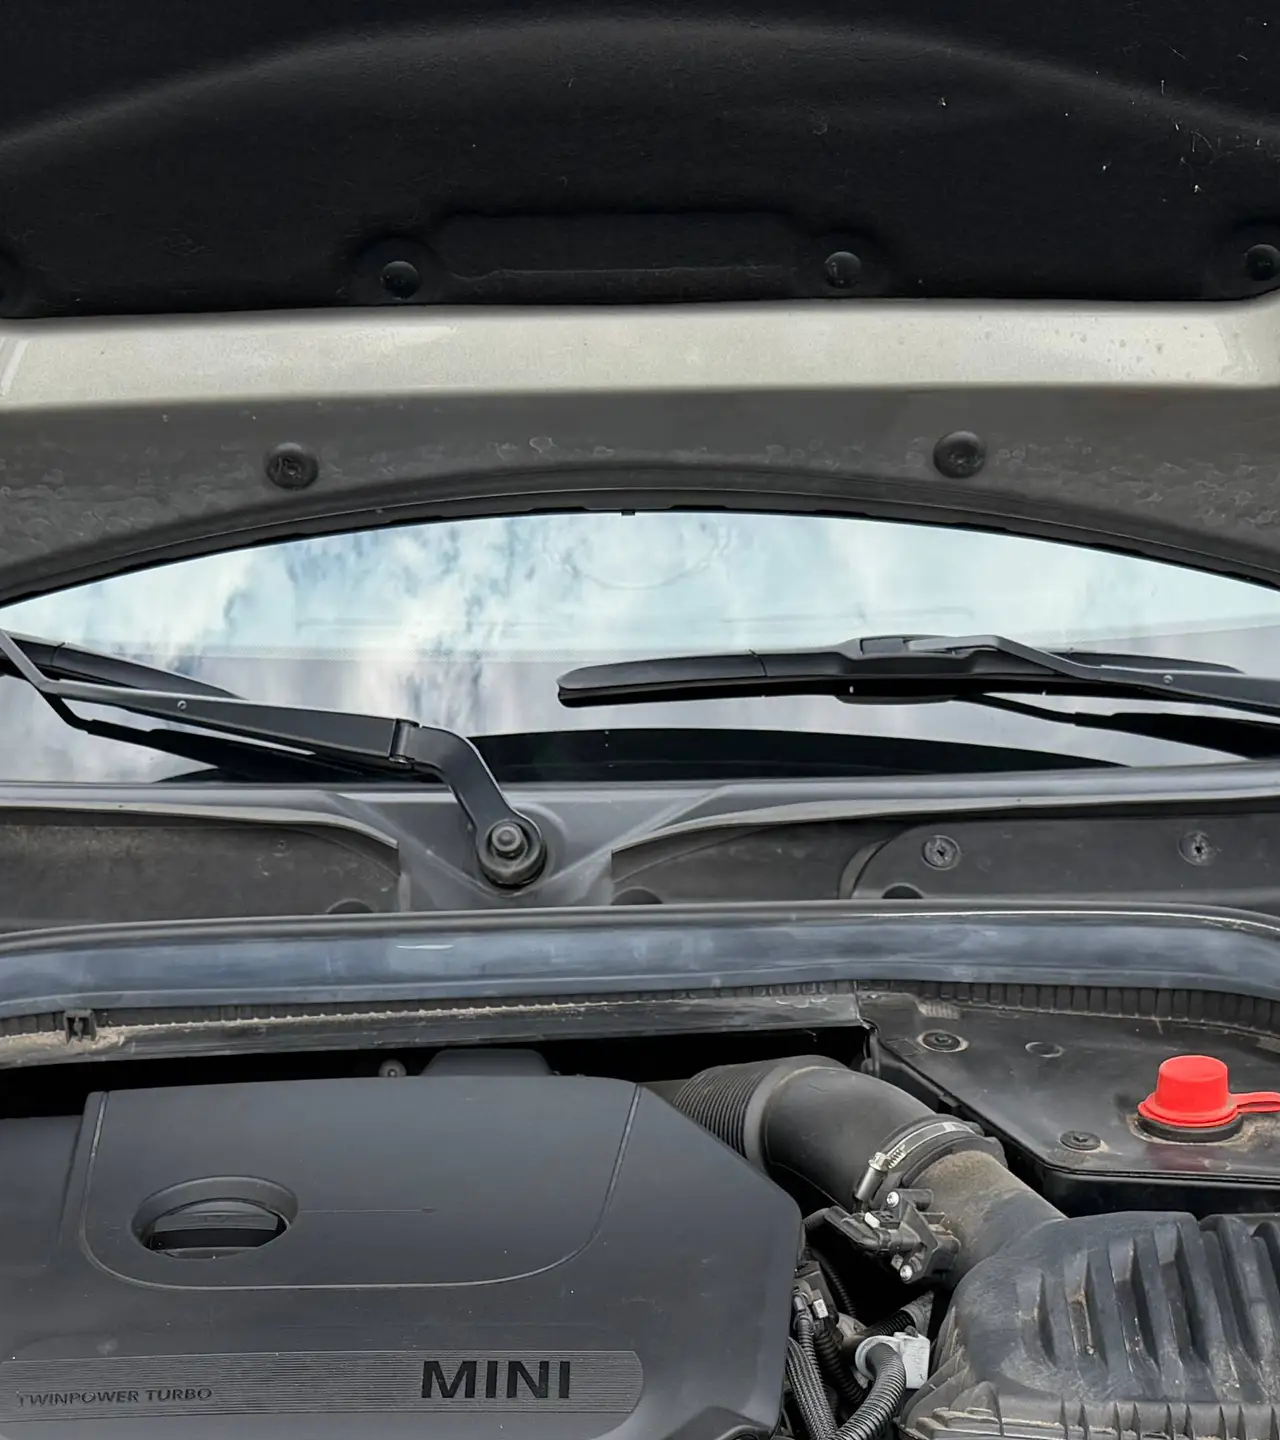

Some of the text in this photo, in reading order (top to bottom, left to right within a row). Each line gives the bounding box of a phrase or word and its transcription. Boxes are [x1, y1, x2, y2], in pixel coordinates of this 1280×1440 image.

[420, 1359, 572, 1400] MINI
[17, 1387, 213, 1407] TWINPOWER TURBO
